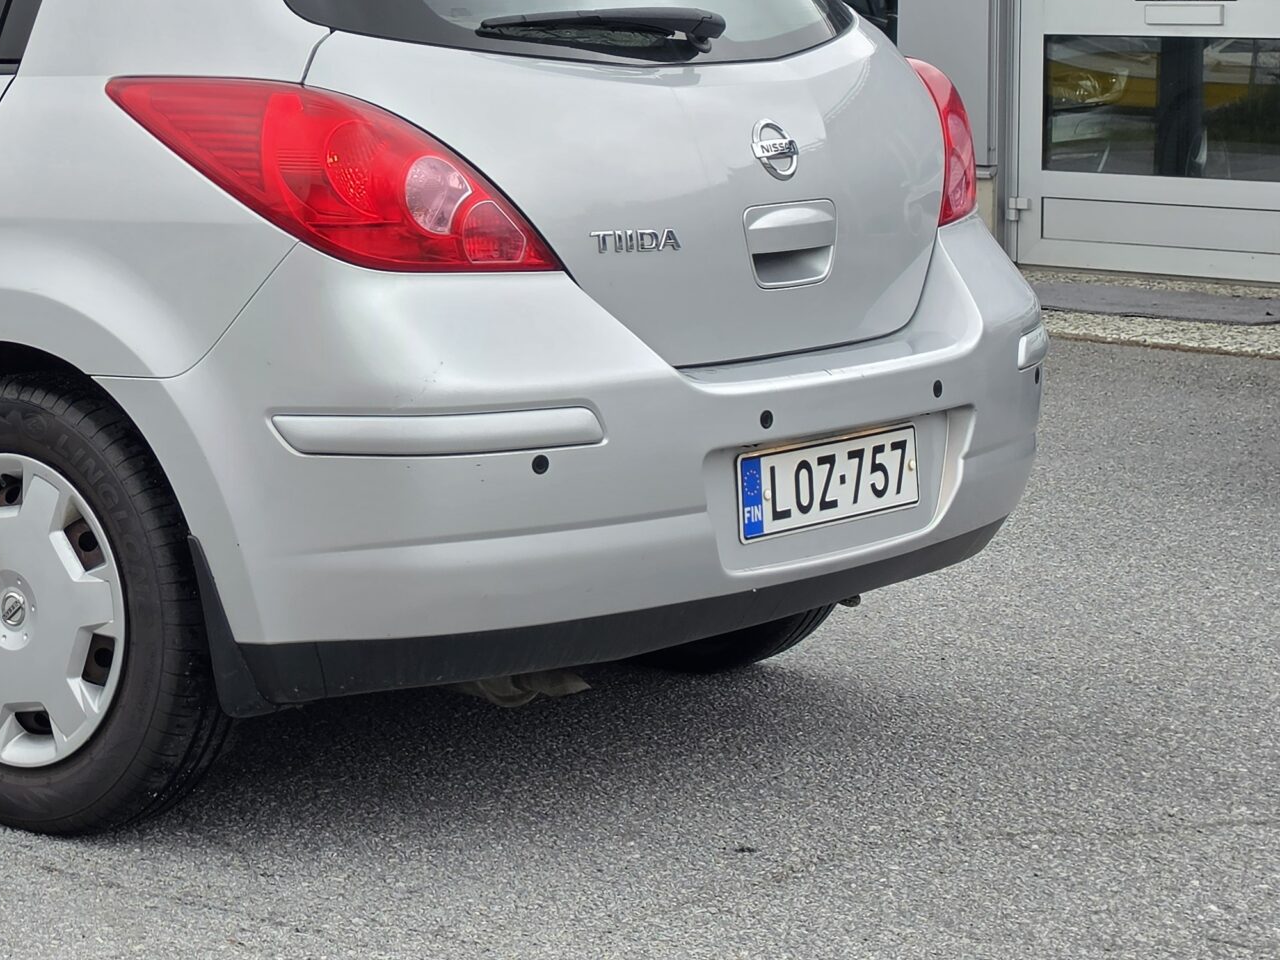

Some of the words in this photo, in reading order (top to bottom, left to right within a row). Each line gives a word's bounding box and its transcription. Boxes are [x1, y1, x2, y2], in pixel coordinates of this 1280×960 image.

[760, 142, 798, 154] NISSAN
[589, 228, 682, 253] TIIDA
[744, 504, 763, 524] FIN
[770, 439, 908, 521] LOZ-757
